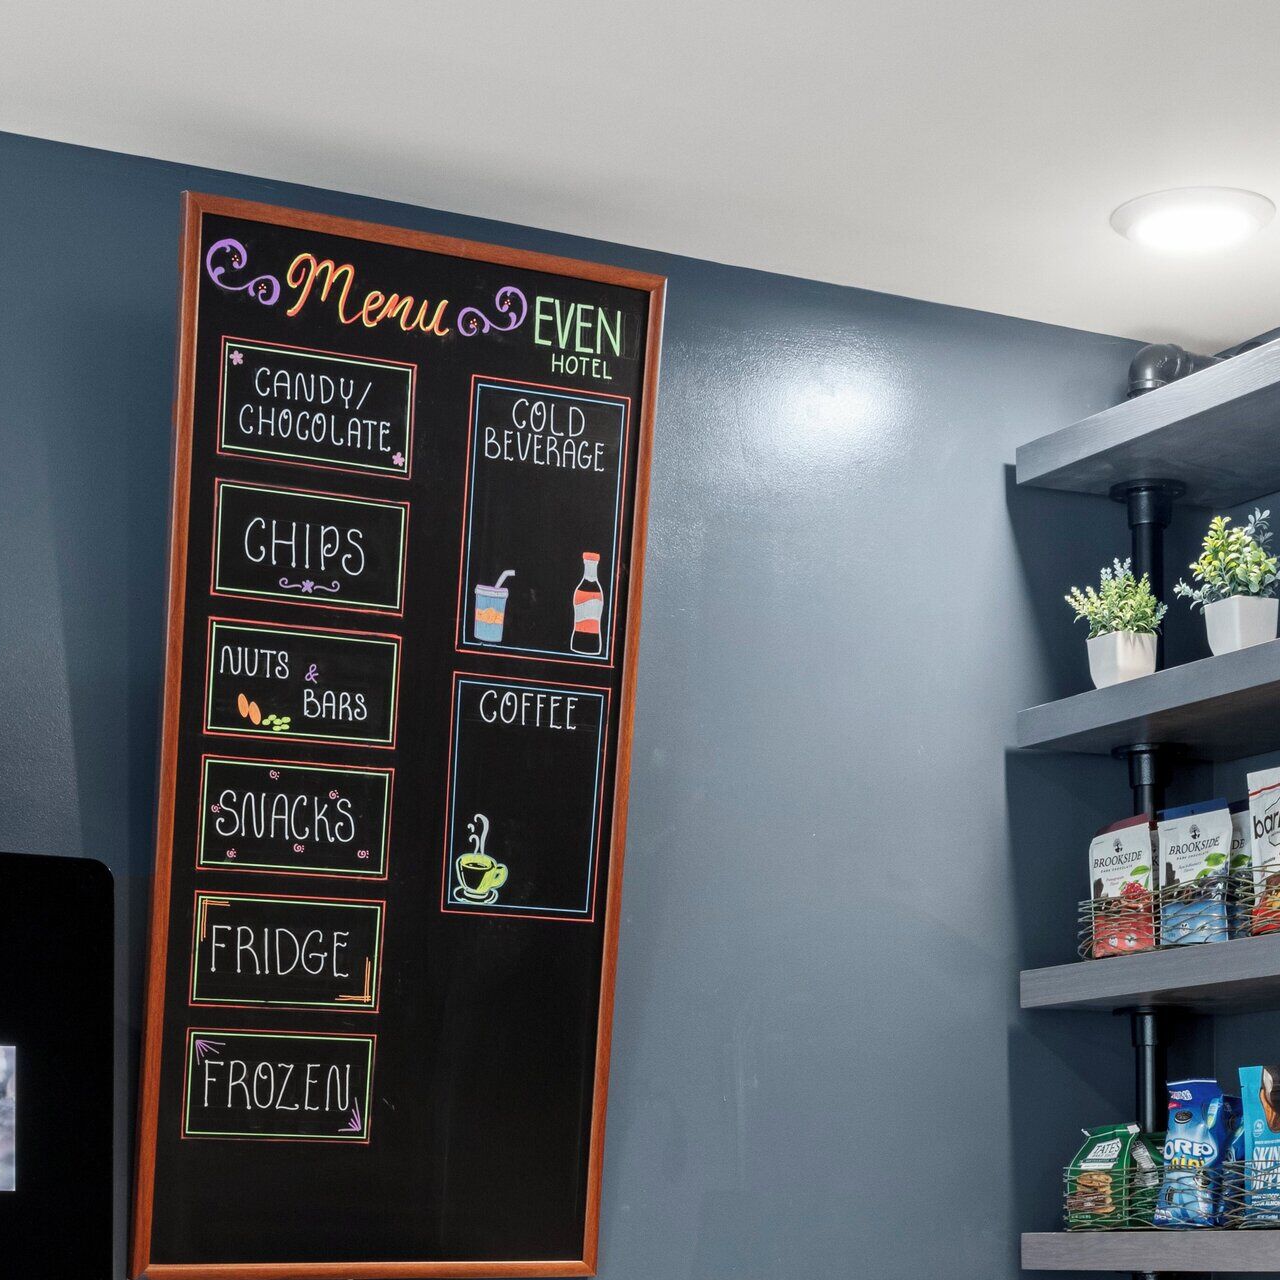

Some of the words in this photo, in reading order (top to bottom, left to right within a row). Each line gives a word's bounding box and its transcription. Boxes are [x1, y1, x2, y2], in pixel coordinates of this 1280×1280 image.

[286, 252, 452, 338] Menu
[534, 296, 622, 358] EVEN
[254, 366, 373, 411] CANDY/
[551, 353, 613, 381] HOTEL
[238, 403, 393, 454] CHOCOLATE
[511, 398, 587, 437] COLD
[484, 427, 605, 473] BEVERAGE
[243, 516, 366, 578] CHIPS
[219, 645, 290, 680] NUTS
[304, 663, 320, 685] &
[303, 688, 368, 721] BARS
[478, 690, 578, 731] COFFEE
[215, 790, 355, 843] SNACKS
[1093, 850, 1143, 869] BROOKSIDE
[1168, 835, 1220, 856] BROOKSIDE
[209, 924, 349, 978] FRIDGE
[203, 1060, 352, 1111] FROZEN
[1164, 1139, 1215, 1160] OREO
